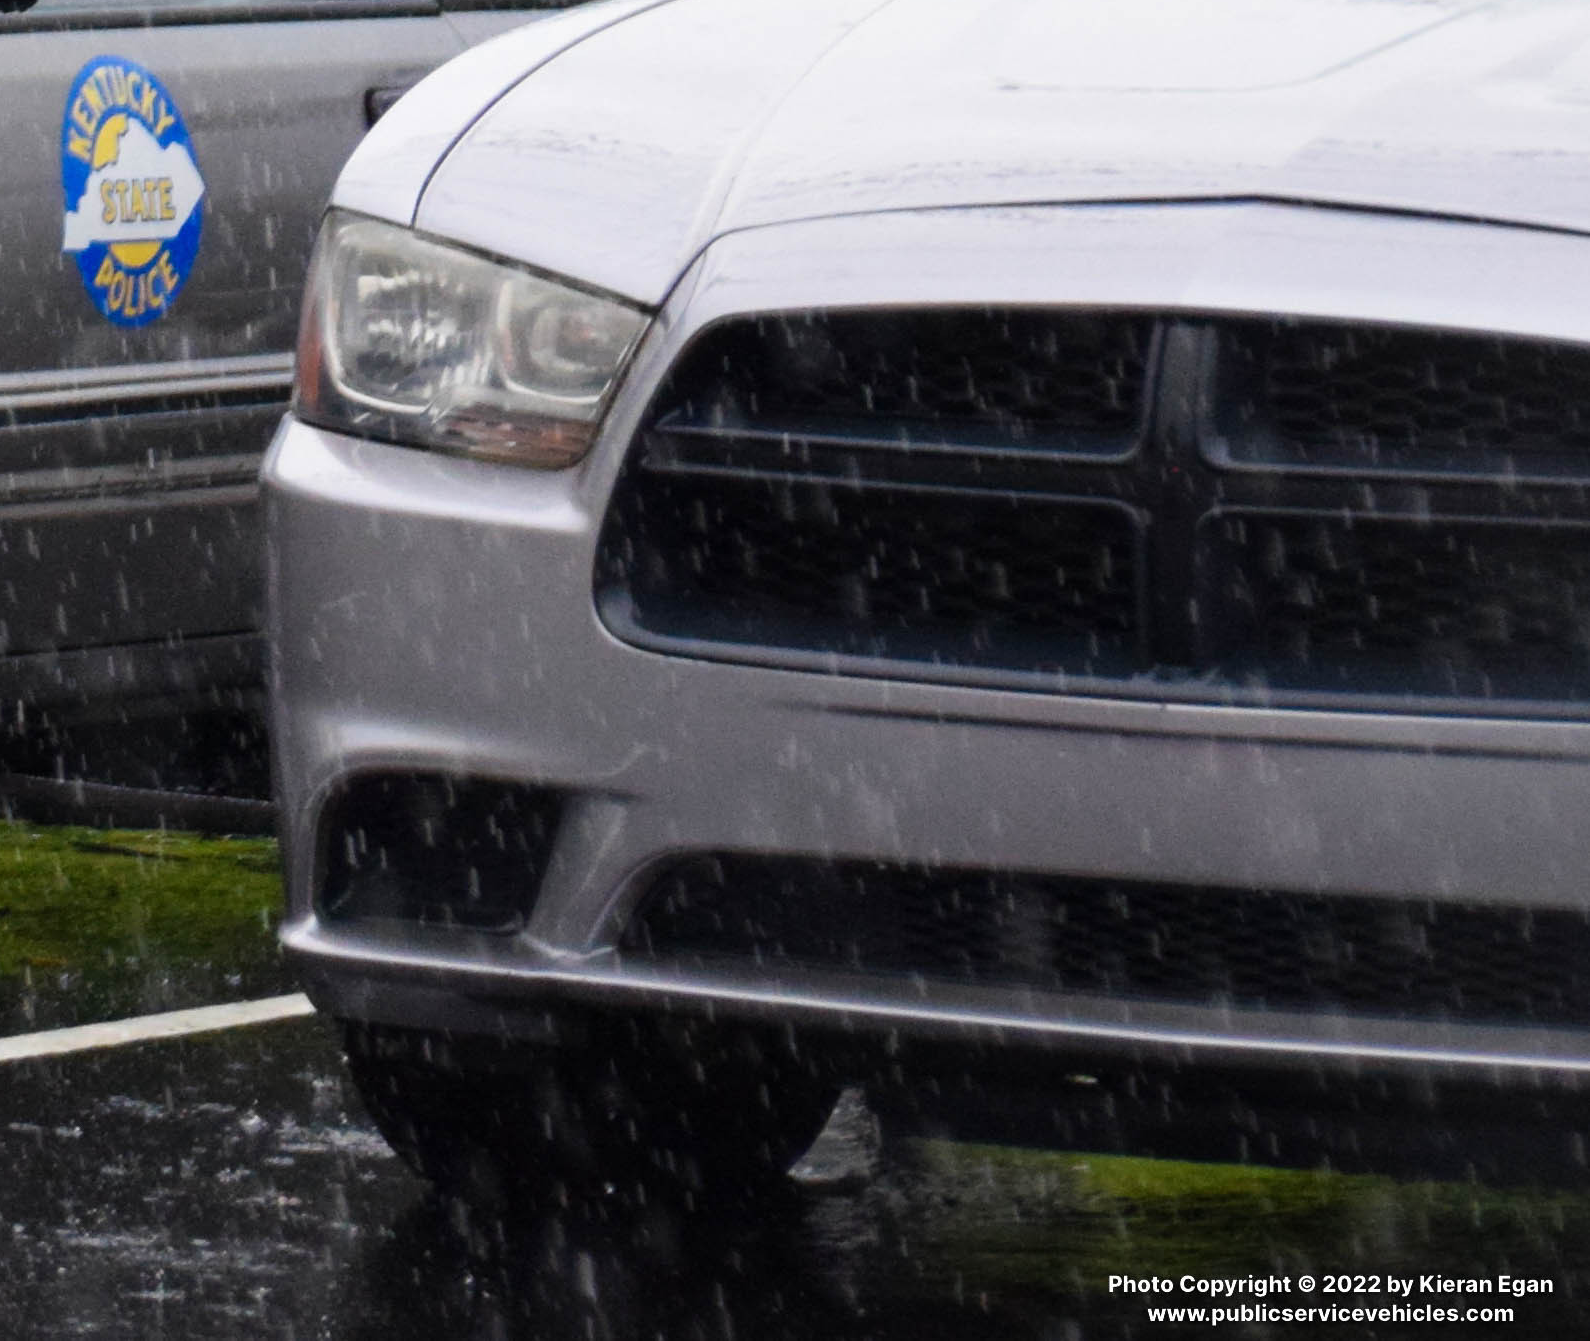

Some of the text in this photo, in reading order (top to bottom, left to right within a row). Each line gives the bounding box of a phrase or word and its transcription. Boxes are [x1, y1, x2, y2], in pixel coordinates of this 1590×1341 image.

[68, 65, 176, 162] KENTUCKY
[100, 176, 176, 224] STATE
[94, 249, 179, 318] POLICE
